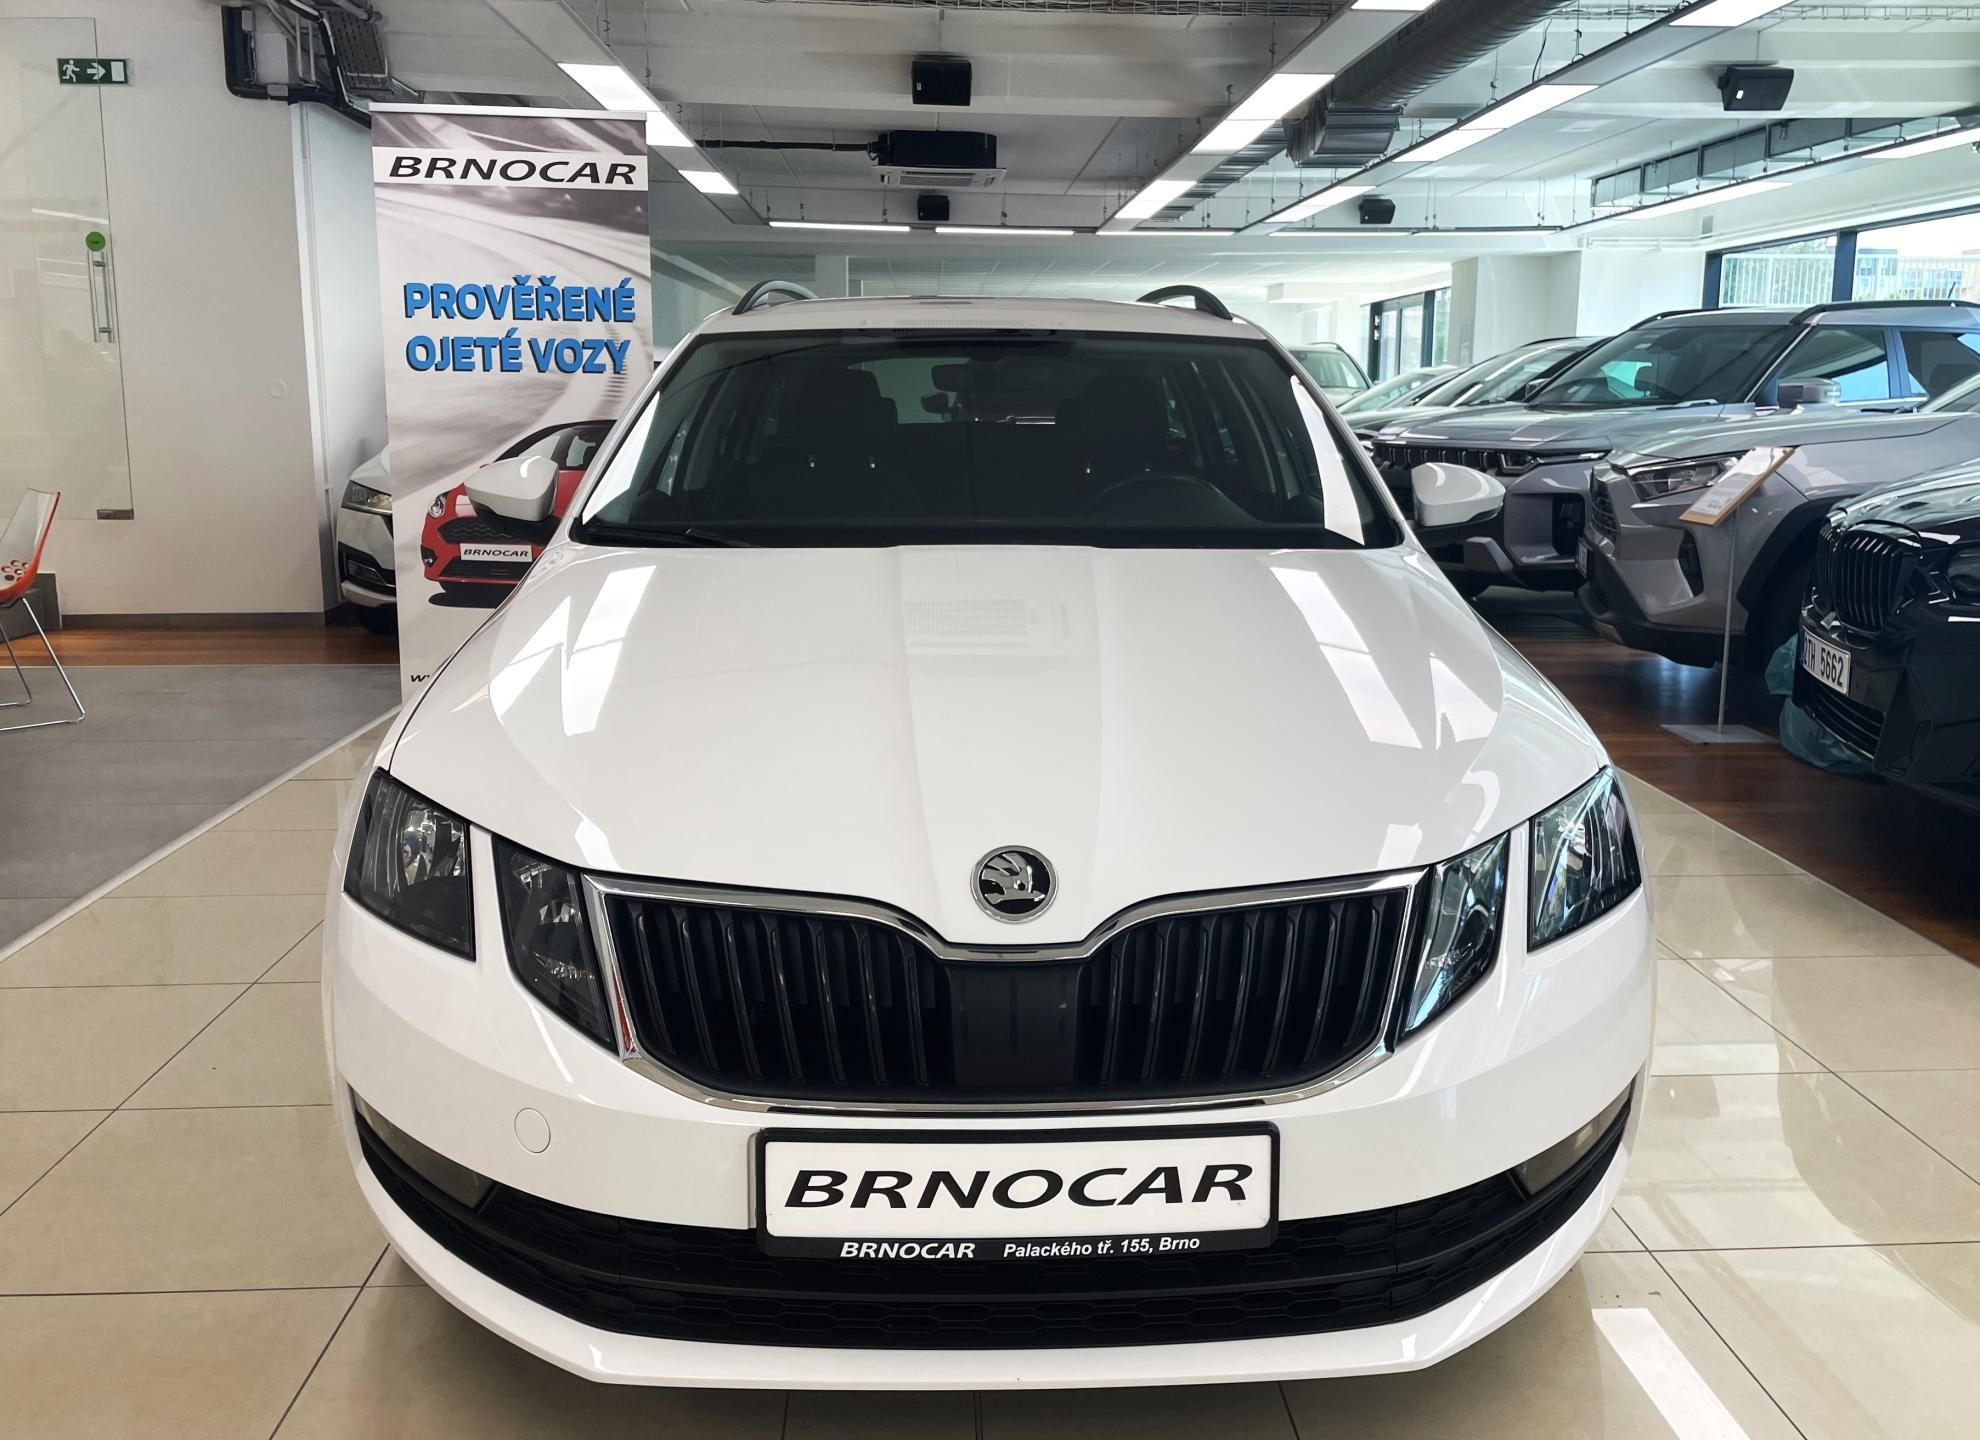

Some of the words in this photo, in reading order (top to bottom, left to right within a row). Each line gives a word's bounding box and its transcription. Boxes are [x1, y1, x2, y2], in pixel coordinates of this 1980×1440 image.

[390, 157, 637, 185] BRNOCAR
[403, 275, 636, 323] PROVĚŘENÉ
[405, 327, 523, 373] OJETÉ
[527, 337, 632, 375] VOZY
[463, 548, 530, 558] BRNOCAR
[1820, 646, 1844, 688] 5662
[785, 1164, 1253, 1209] BRNOCAR
[840, 1242, 976, 1259] BRNOCAR
[1003, 1241, 1093, 1258] Palackého
[1097, 1239, 1114, 1255] tř.
[1121, 1238, 1154, 1254] 155,
[1159, 1236, 1200, 1251] Brno
